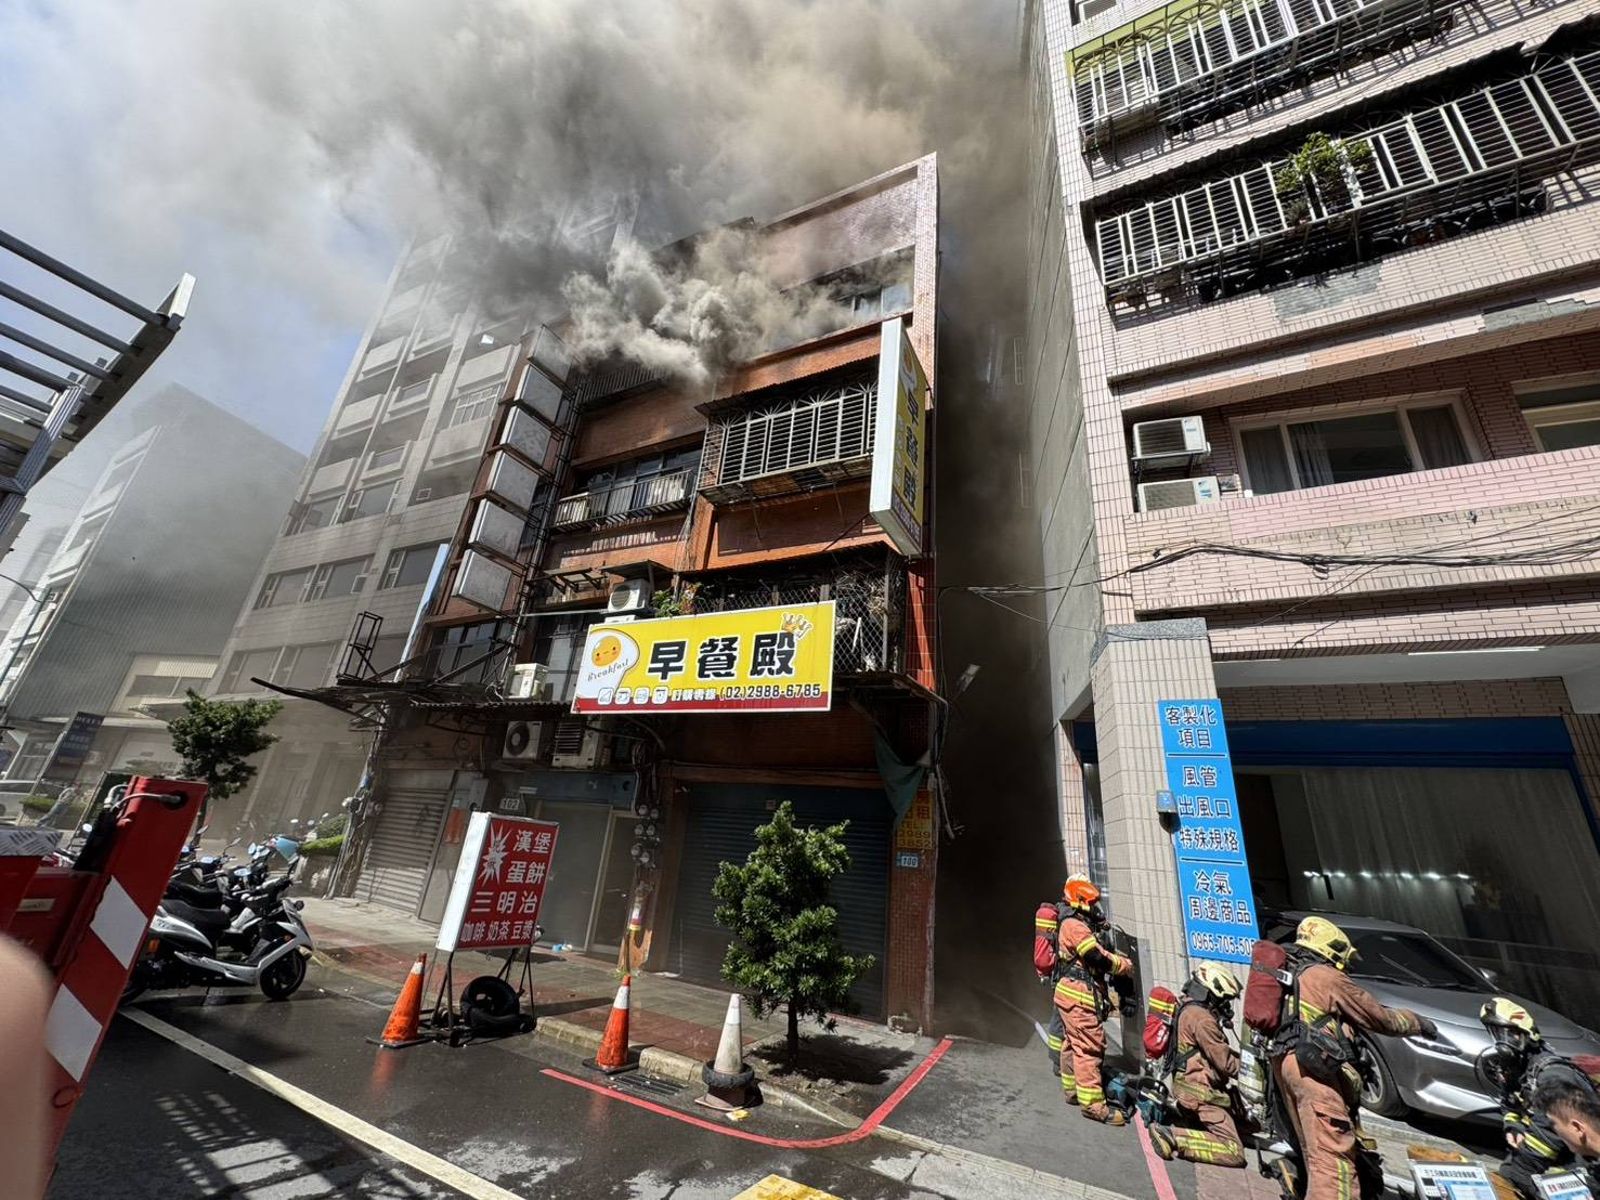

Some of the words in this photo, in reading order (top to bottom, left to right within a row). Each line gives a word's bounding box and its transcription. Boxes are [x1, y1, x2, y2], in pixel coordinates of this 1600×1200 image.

[647, 631, 797, 681] 早餐殿
[719, 683, 821, 700] (02)2988-6785
[1165, 706, 1217, 726] 客製化
[1179, 729, 1212, 748] 項目
[1182, 765, 1217, 787] 風管
[1178, 795, 1231, 819] 出風口
[513, 830, 551, 853] 漢堡
[1179, 828, 1239, 851] 特殊規格
[506, 861, 545, 884] 蛋餅
[1194, 871, 1231, 895] 冷氣
[471, 890, 538, 914] 三明治
[1189, 897, 1251, 923] 周邊商品
[460, 922, 485, 941] 咖啡
[486, 921, 510, 940] 奶茶
